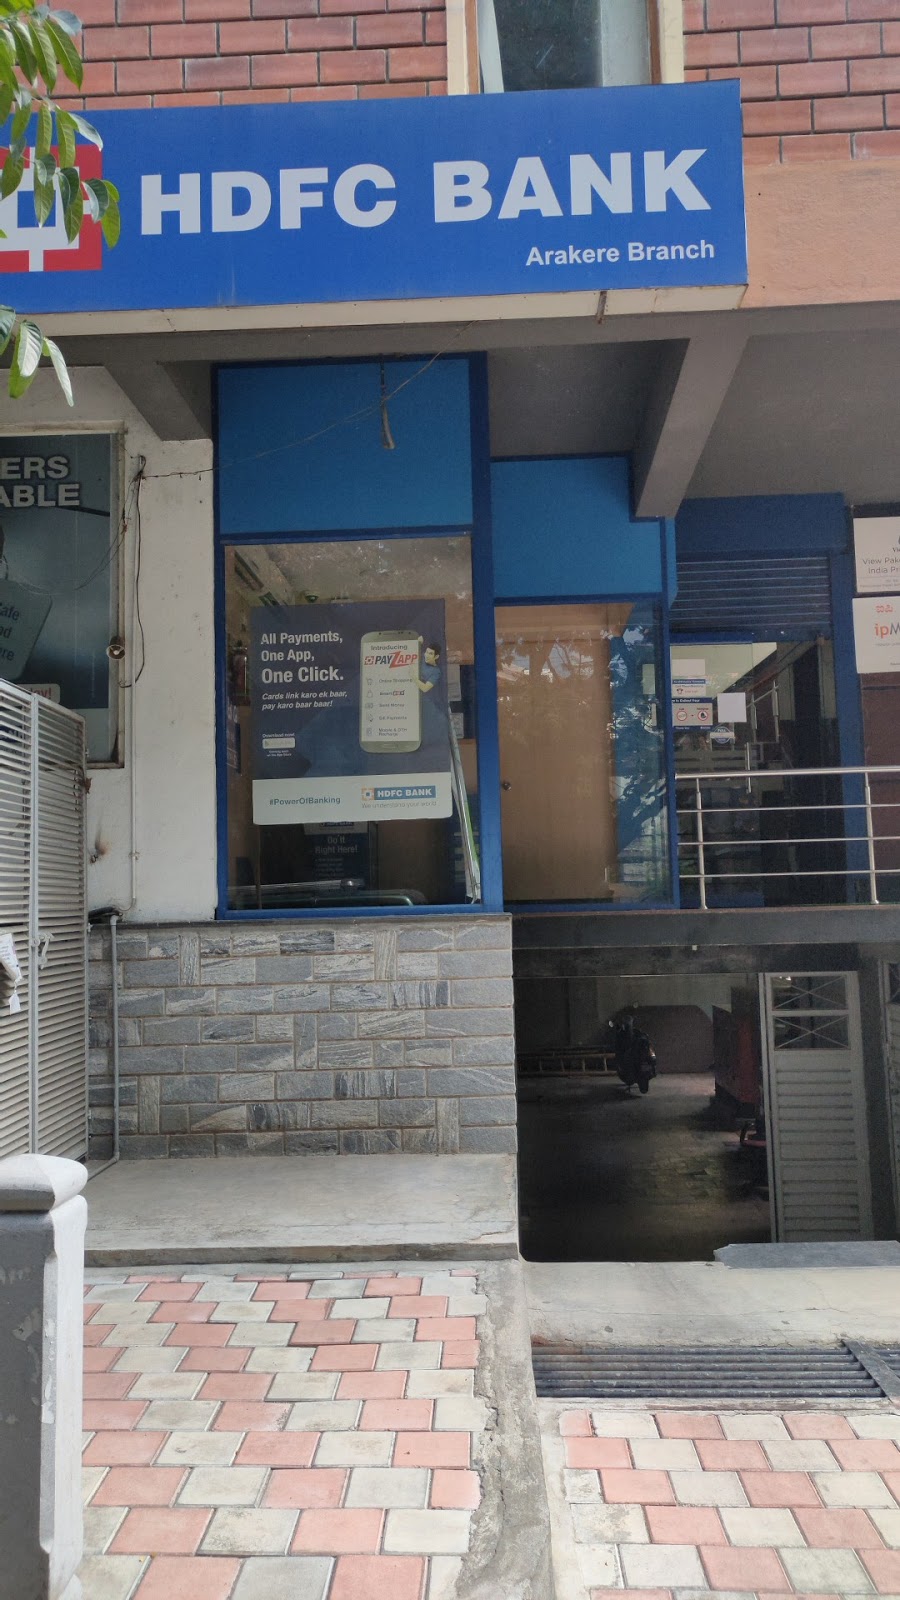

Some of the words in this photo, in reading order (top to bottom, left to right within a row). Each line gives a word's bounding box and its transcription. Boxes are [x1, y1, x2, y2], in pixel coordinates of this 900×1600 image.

[140, 163, 397, 236] HDFC
[433, 149, 711, 225] BANK
[526, 245, 620, 267] Arakere
[628, 240, 715, 263] Branch
[261, 633, 277, 644] All
[280, 631, 343, 646] Payments,
[261, 650, 284, 662] One
[287, 649, 315, 662] App,
[262, 668, 293, 684] One
[298, 666, 344, 682] Click.
[262, 692, 284, 700] Cards
[301, 691, 317, 699] karo
[330, 690, 348, 698] baar,
[262, 703, 276, 711] pay
[313, 700, 333, 708] baar!
[377, 790, 402, 798] HDFC
[405, 788, 432, 796] BANK
[269, 796, 341, 807] #PowerOfBanking
[327, 836, 338, 844] Do
[315, 845, 336, 855] Right
[337, 844, 358, 853] Here!
